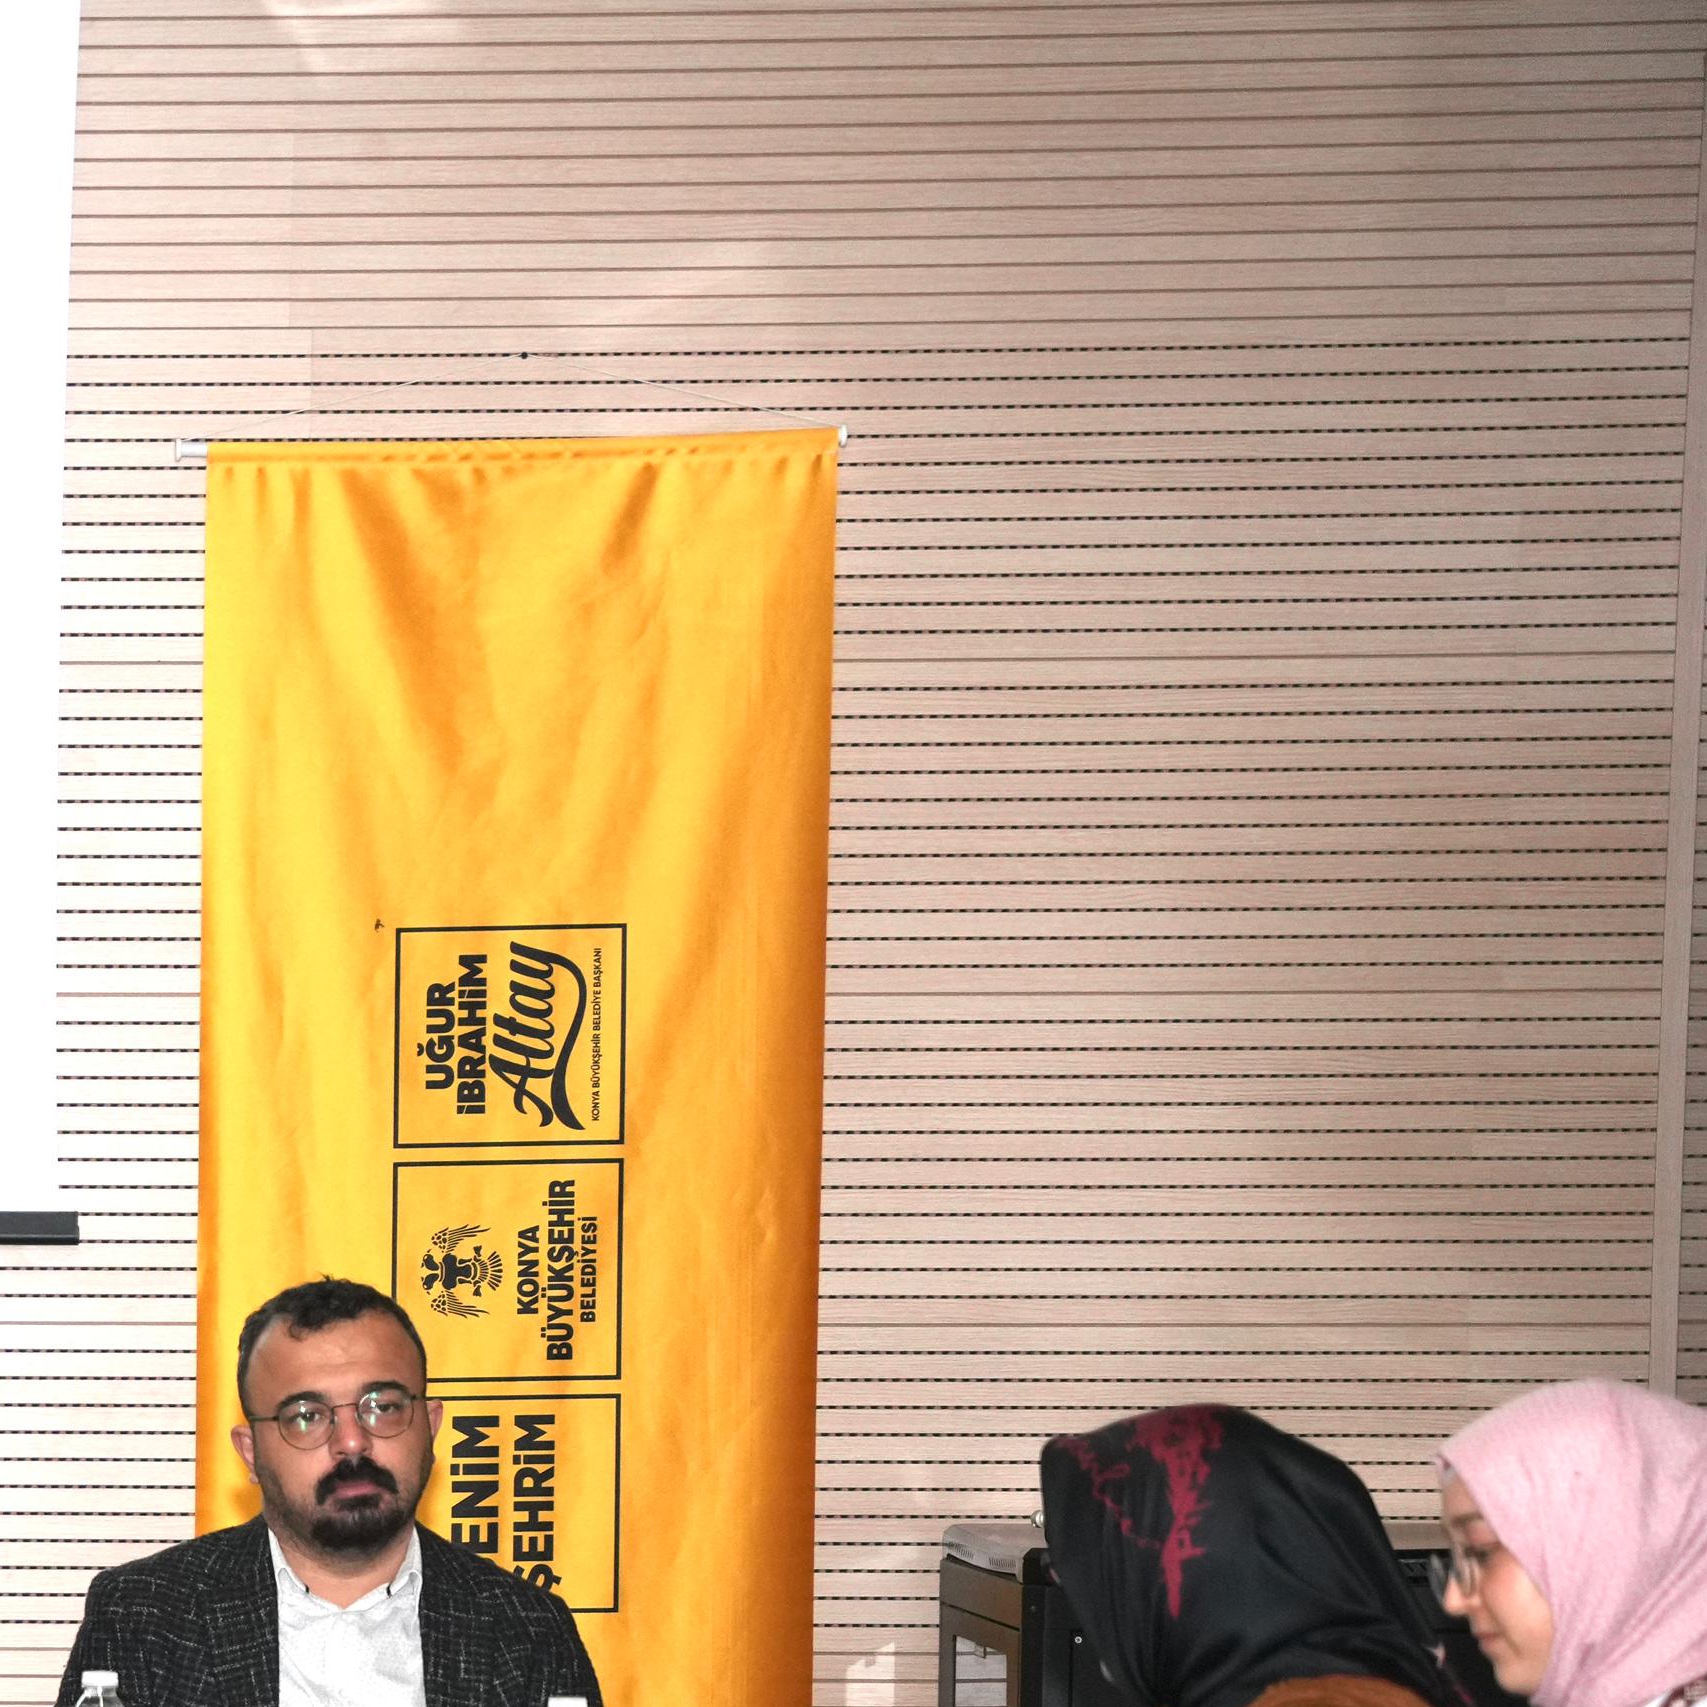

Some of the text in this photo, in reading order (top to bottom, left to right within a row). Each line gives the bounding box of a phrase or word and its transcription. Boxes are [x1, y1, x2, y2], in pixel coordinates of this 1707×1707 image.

[417, 982, 456, 1090] UĞUR
[457, 954, 488, 1115] İBRAHİM
[488, 940, 588, 1131] Altay
[590, 947, 604, 1122] KONYA BÜYÜKŞEHİR BELEDİYE BAŞKANI
[517, 1225, 540, 1316] KONYA
[540, 1179, 579, 1361] BÜYÜKŞEHİR
[578, 1216, 599, 1323] BELEDİYESİ
[450, 1414, 501, 1555] ENİM
